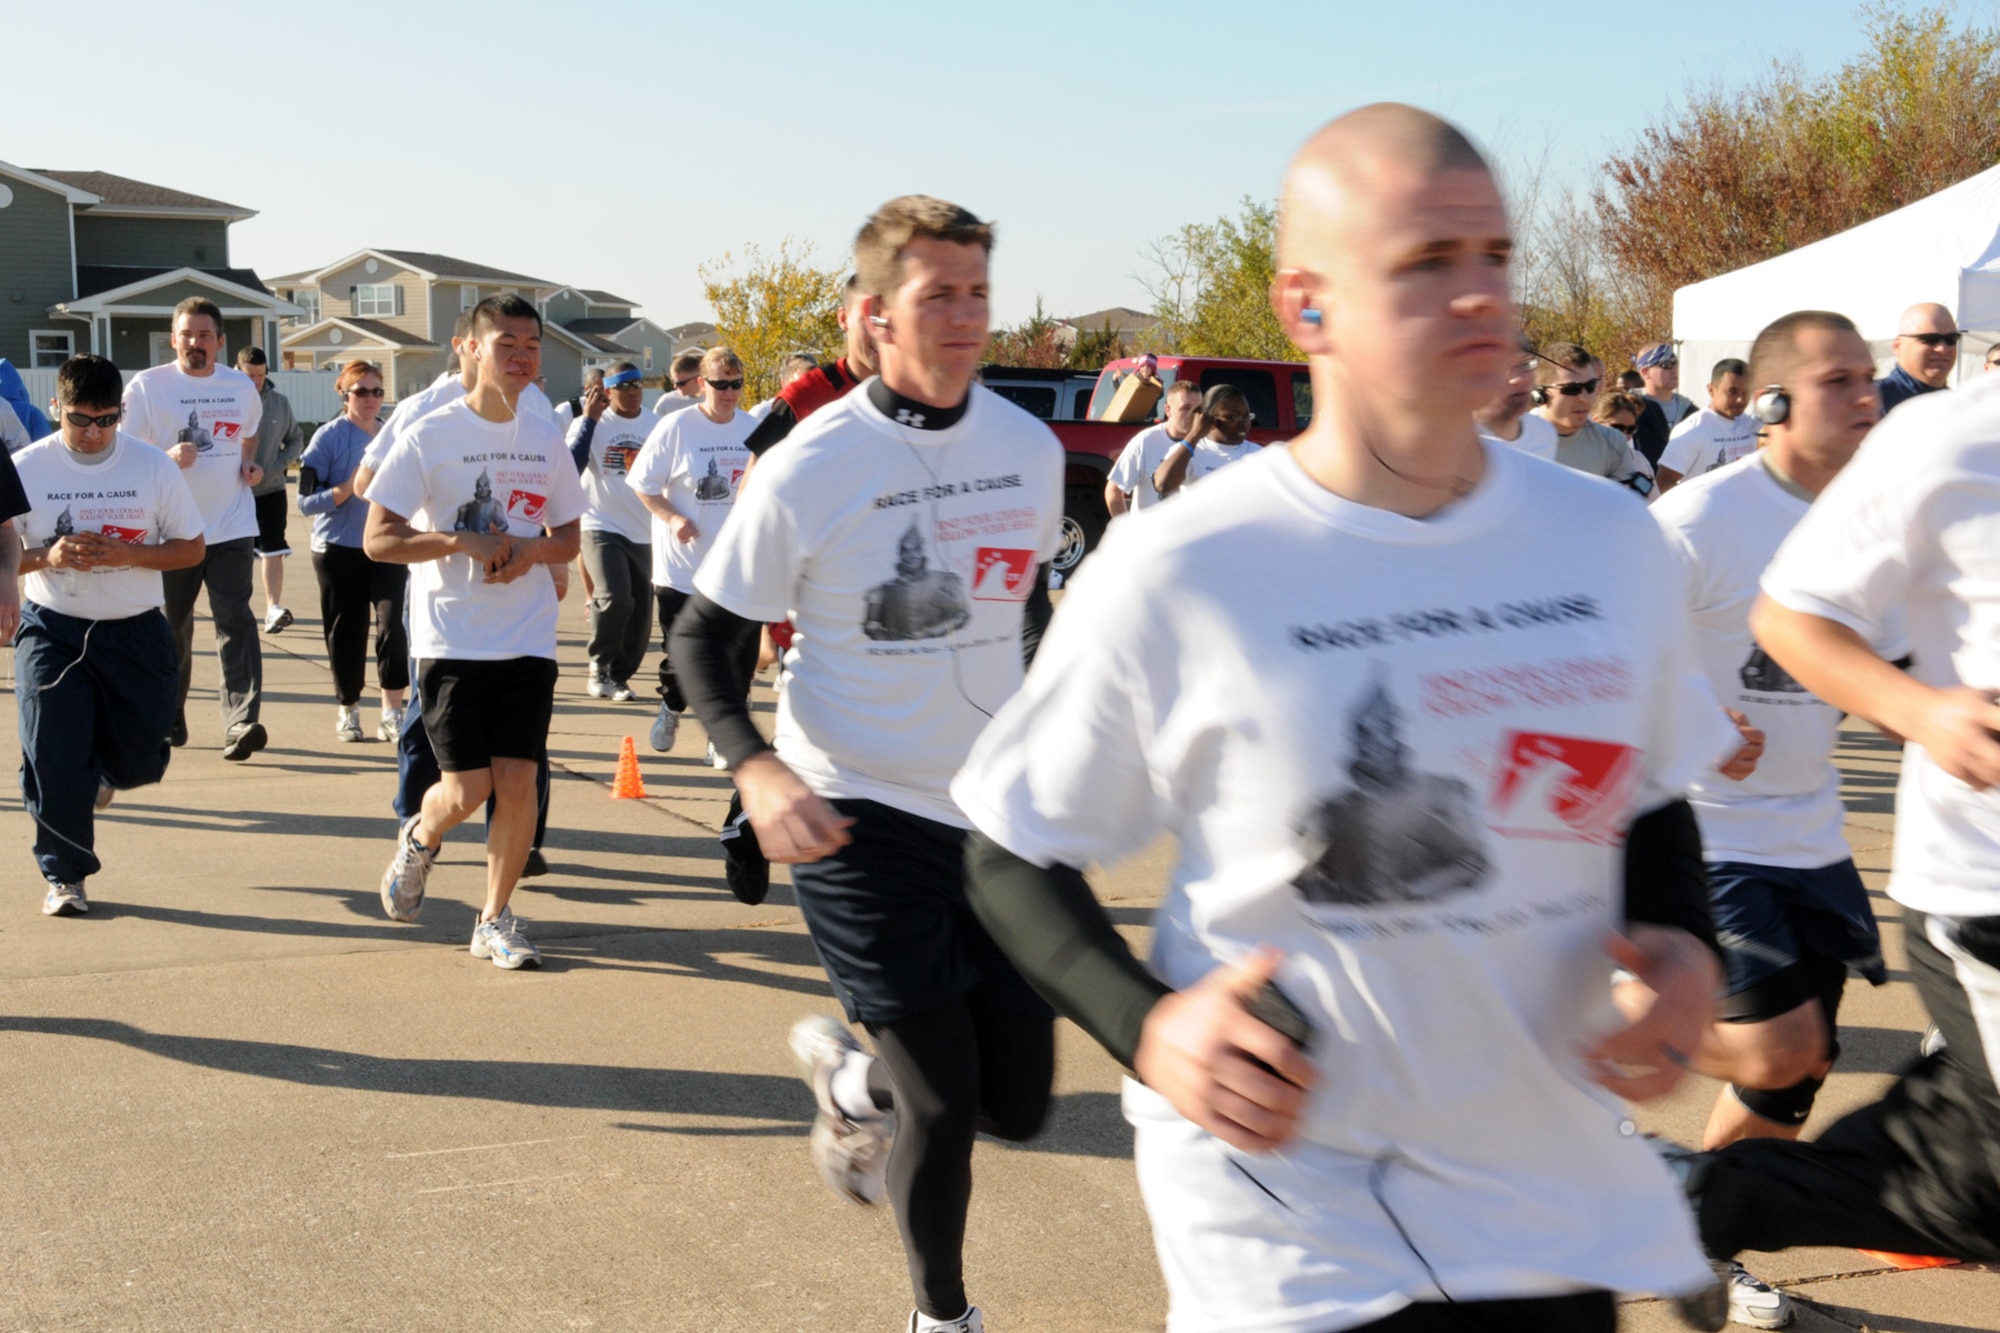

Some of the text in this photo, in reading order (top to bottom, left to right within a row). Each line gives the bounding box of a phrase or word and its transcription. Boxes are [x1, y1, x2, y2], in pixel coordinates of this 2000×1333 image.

[463, 453, 488, 463] RACE
[922, 484, 957, 500] FOR
[960, 481, 972, 493] A
[974, 474, 1022, 492] CAUSE
[47, 490, 137, 501] RACE FOR A CAUSE
